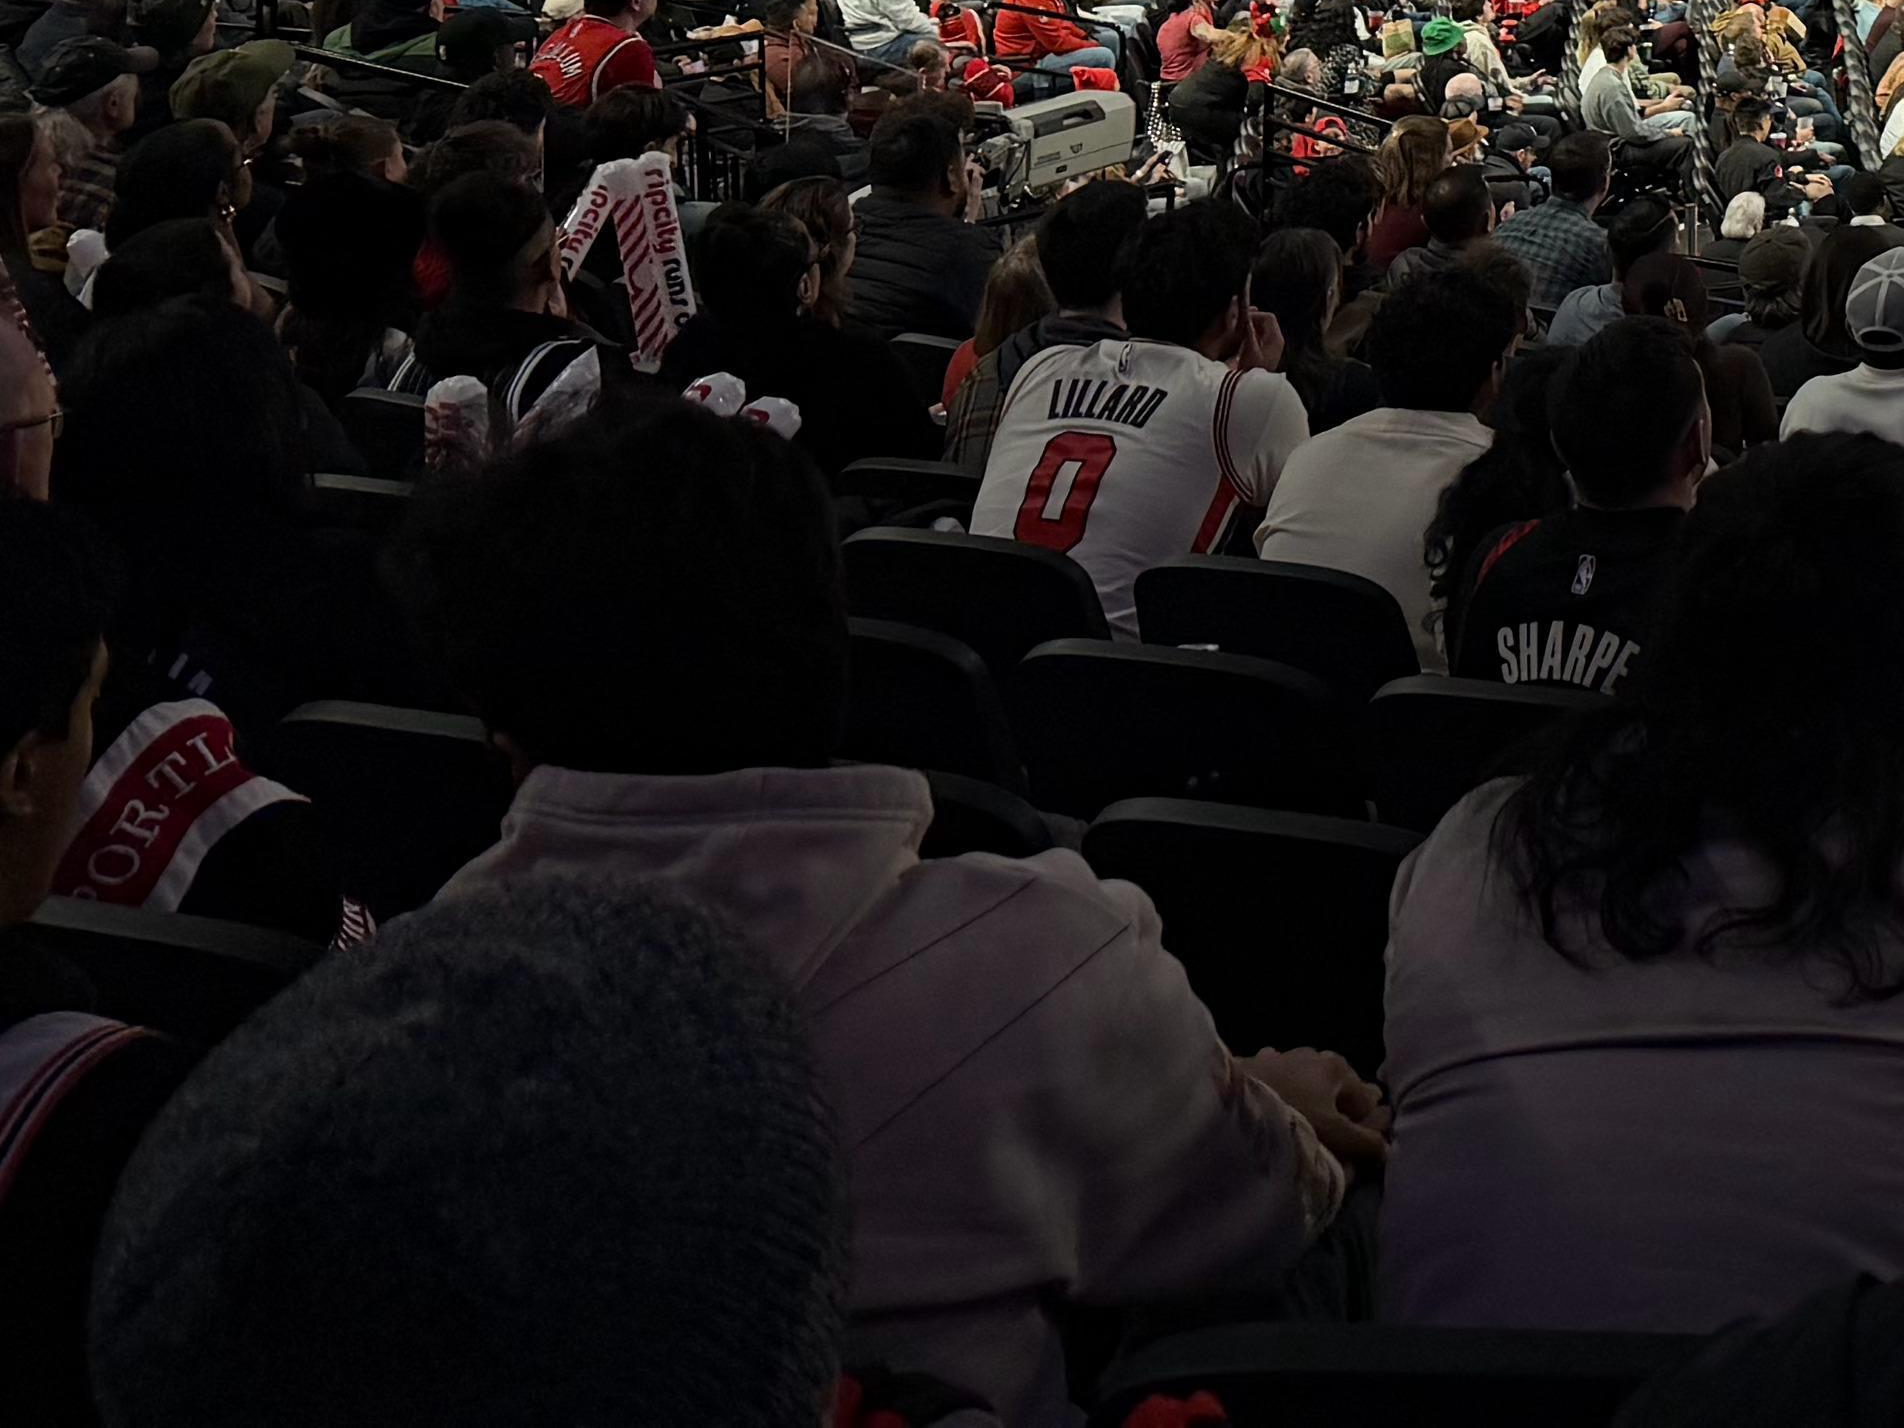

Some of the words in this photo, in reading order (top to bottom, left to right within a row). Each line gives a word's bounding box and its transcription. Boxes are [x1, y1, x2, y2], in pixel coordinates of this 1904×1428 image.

[645, 169, 678, 254] ripcity
[1048, 378, 1167, 428] LILLARD
[1014, 432, 1116, 553] 0
[1497, 621, 1639, 694] SHARPE
